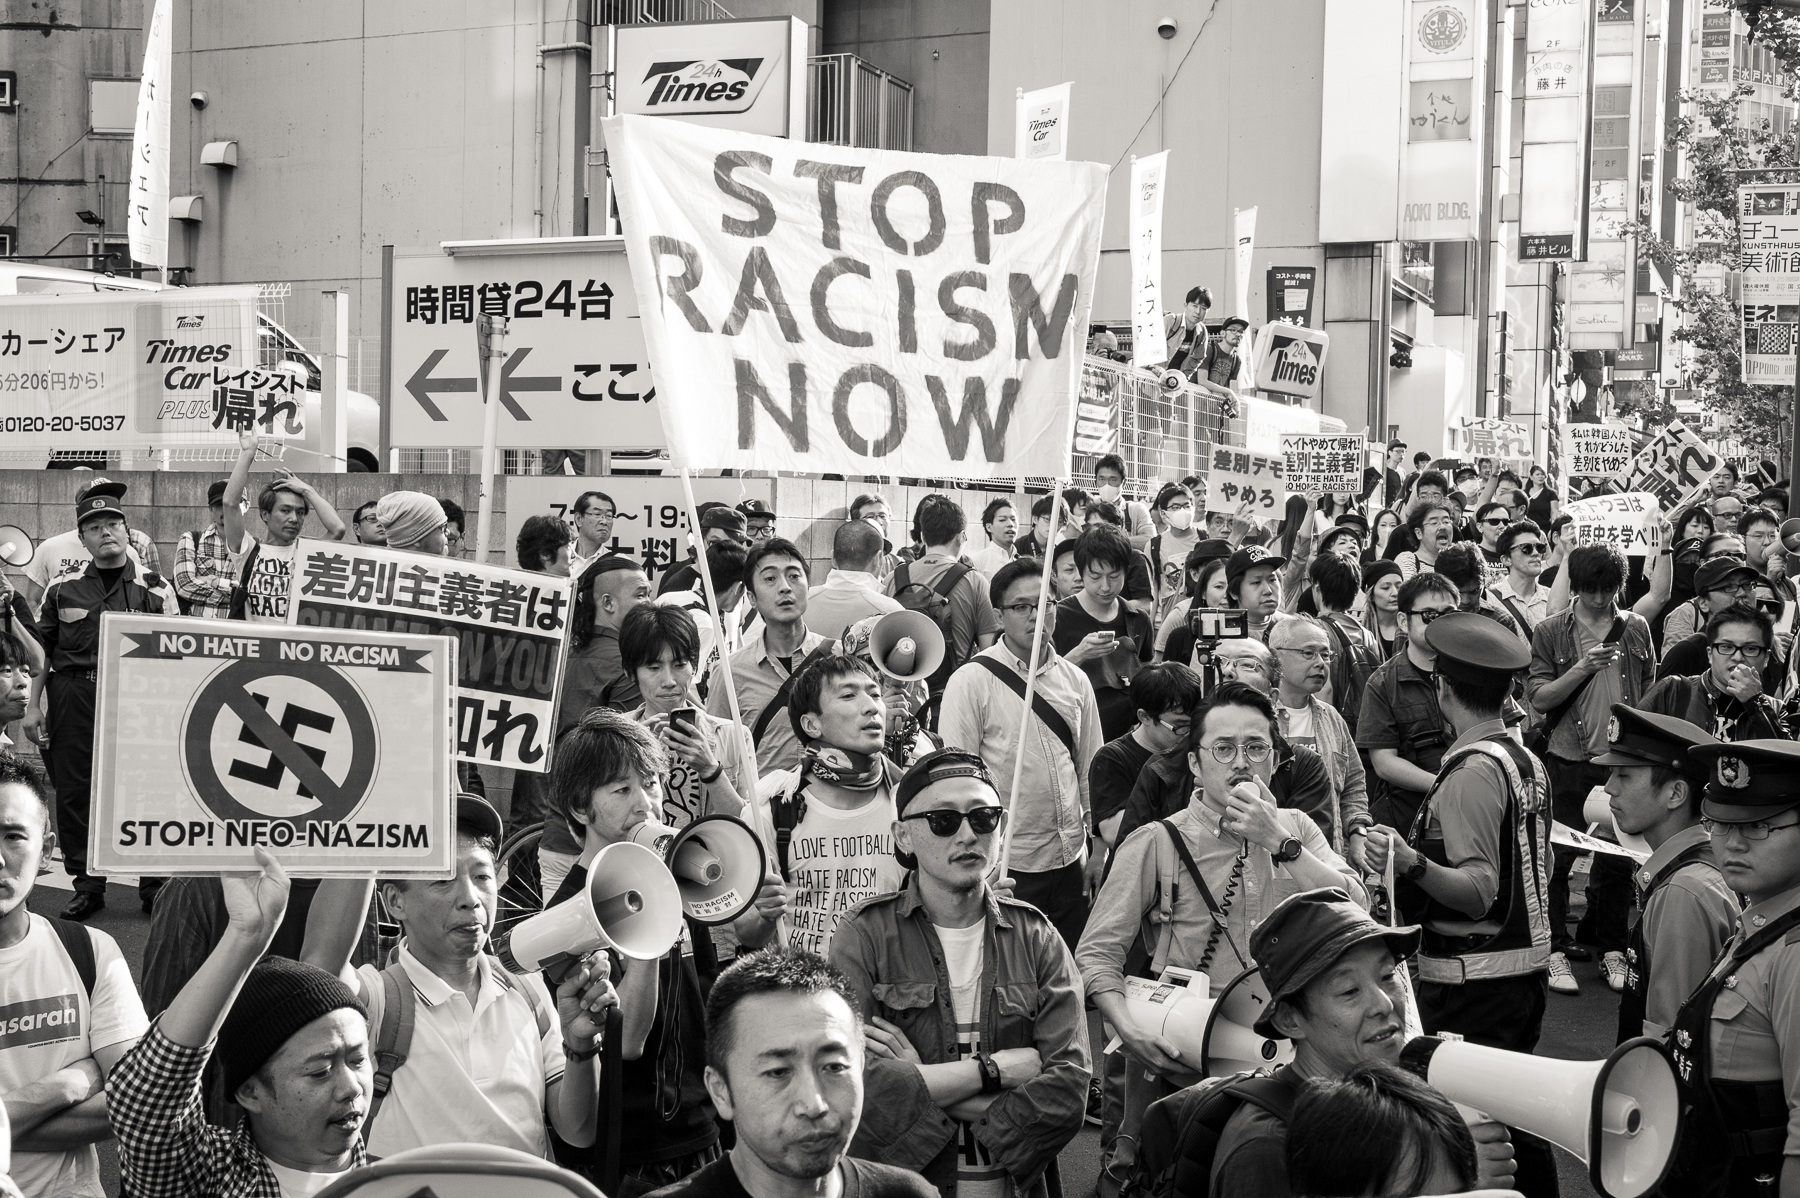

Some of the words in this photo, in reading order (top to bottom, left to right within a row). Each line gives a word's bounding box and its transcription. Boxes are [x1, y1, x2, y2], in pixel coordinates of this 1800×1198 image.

[646, 74, 749, 106] Times
[1029, 118, 1058, 132] Times
[1033, 131, 1049, 141] Car
[714, 150, 1026, 264] STOP
[1404, 203, 1432, 222] AOKI
[1437, 202, 1471, 221] BLDG.
[1526, 244, 1571, 257] 藤井ビル
[1742, 242, 1800, 250] KUNSTHAUS
[406, 279, 615, 324] 時間貸24台
[648, 236, 1079, 361] RACISM
[176, 316, 205, 329] Times
[1, 327, 126, 356] カーシェア
[146, 339, 232, 364] Times
[164, 366, 211, 391] Car
[212, 365, 305, 394] レイシスト
[1271, 349, 1317, 386] Times
[211, 386, 304, 436] 帰れ
[731, 358, 1022, 463] NOW
[5, 415, 126, 432] 0120-20-5037
[1460, 416, 1527, 434] レイシスト
[1571, 427, 1627, 440] 私は韓国人だ
[1283, 437, 1361, 451] ヘイトやめて帰れ!
[1461, 428, 1531, 457] 帰れ
[1575, 441, 1629, 455] それがどうした
[1213, 450, 1284, 479] 差別デモ
[1286, 474, 1302, 482] TOP
[1305, 474, 1321, 483] THE
[1323, 474, 1345, 483] HATE
[1323, 482, 1358, 491] RACISTS!
[1221, 482, 1275, 508] やめろ
[1569, 496, 1646, 514] ネトウヨは
[1578, 514, 1606, 522] 正しい
[301, 552, 566, 631] 差別主義者は
[160, 633, 197, 653] NO
[203, 636, 260, 658] HATE
[280, 641, 314, 661] NO
[320, 644, 400, 666] RACISM
[493, 634, 562, 695] YOU
[119, 820, 215, 847] STOP!
[225, 821, 429, 849] NEO-NAZISM
[793, 837, 828, 860] LOVE
[797, 869, 830, 889] HATE
[836, 868, 877, 889] RACISM
[705, 892, 735, 908] RACISM
[795, 890, 830, 911] HATE
[793, 908, 826, 933] HATE
[790, 929, 824, 955] HATE
